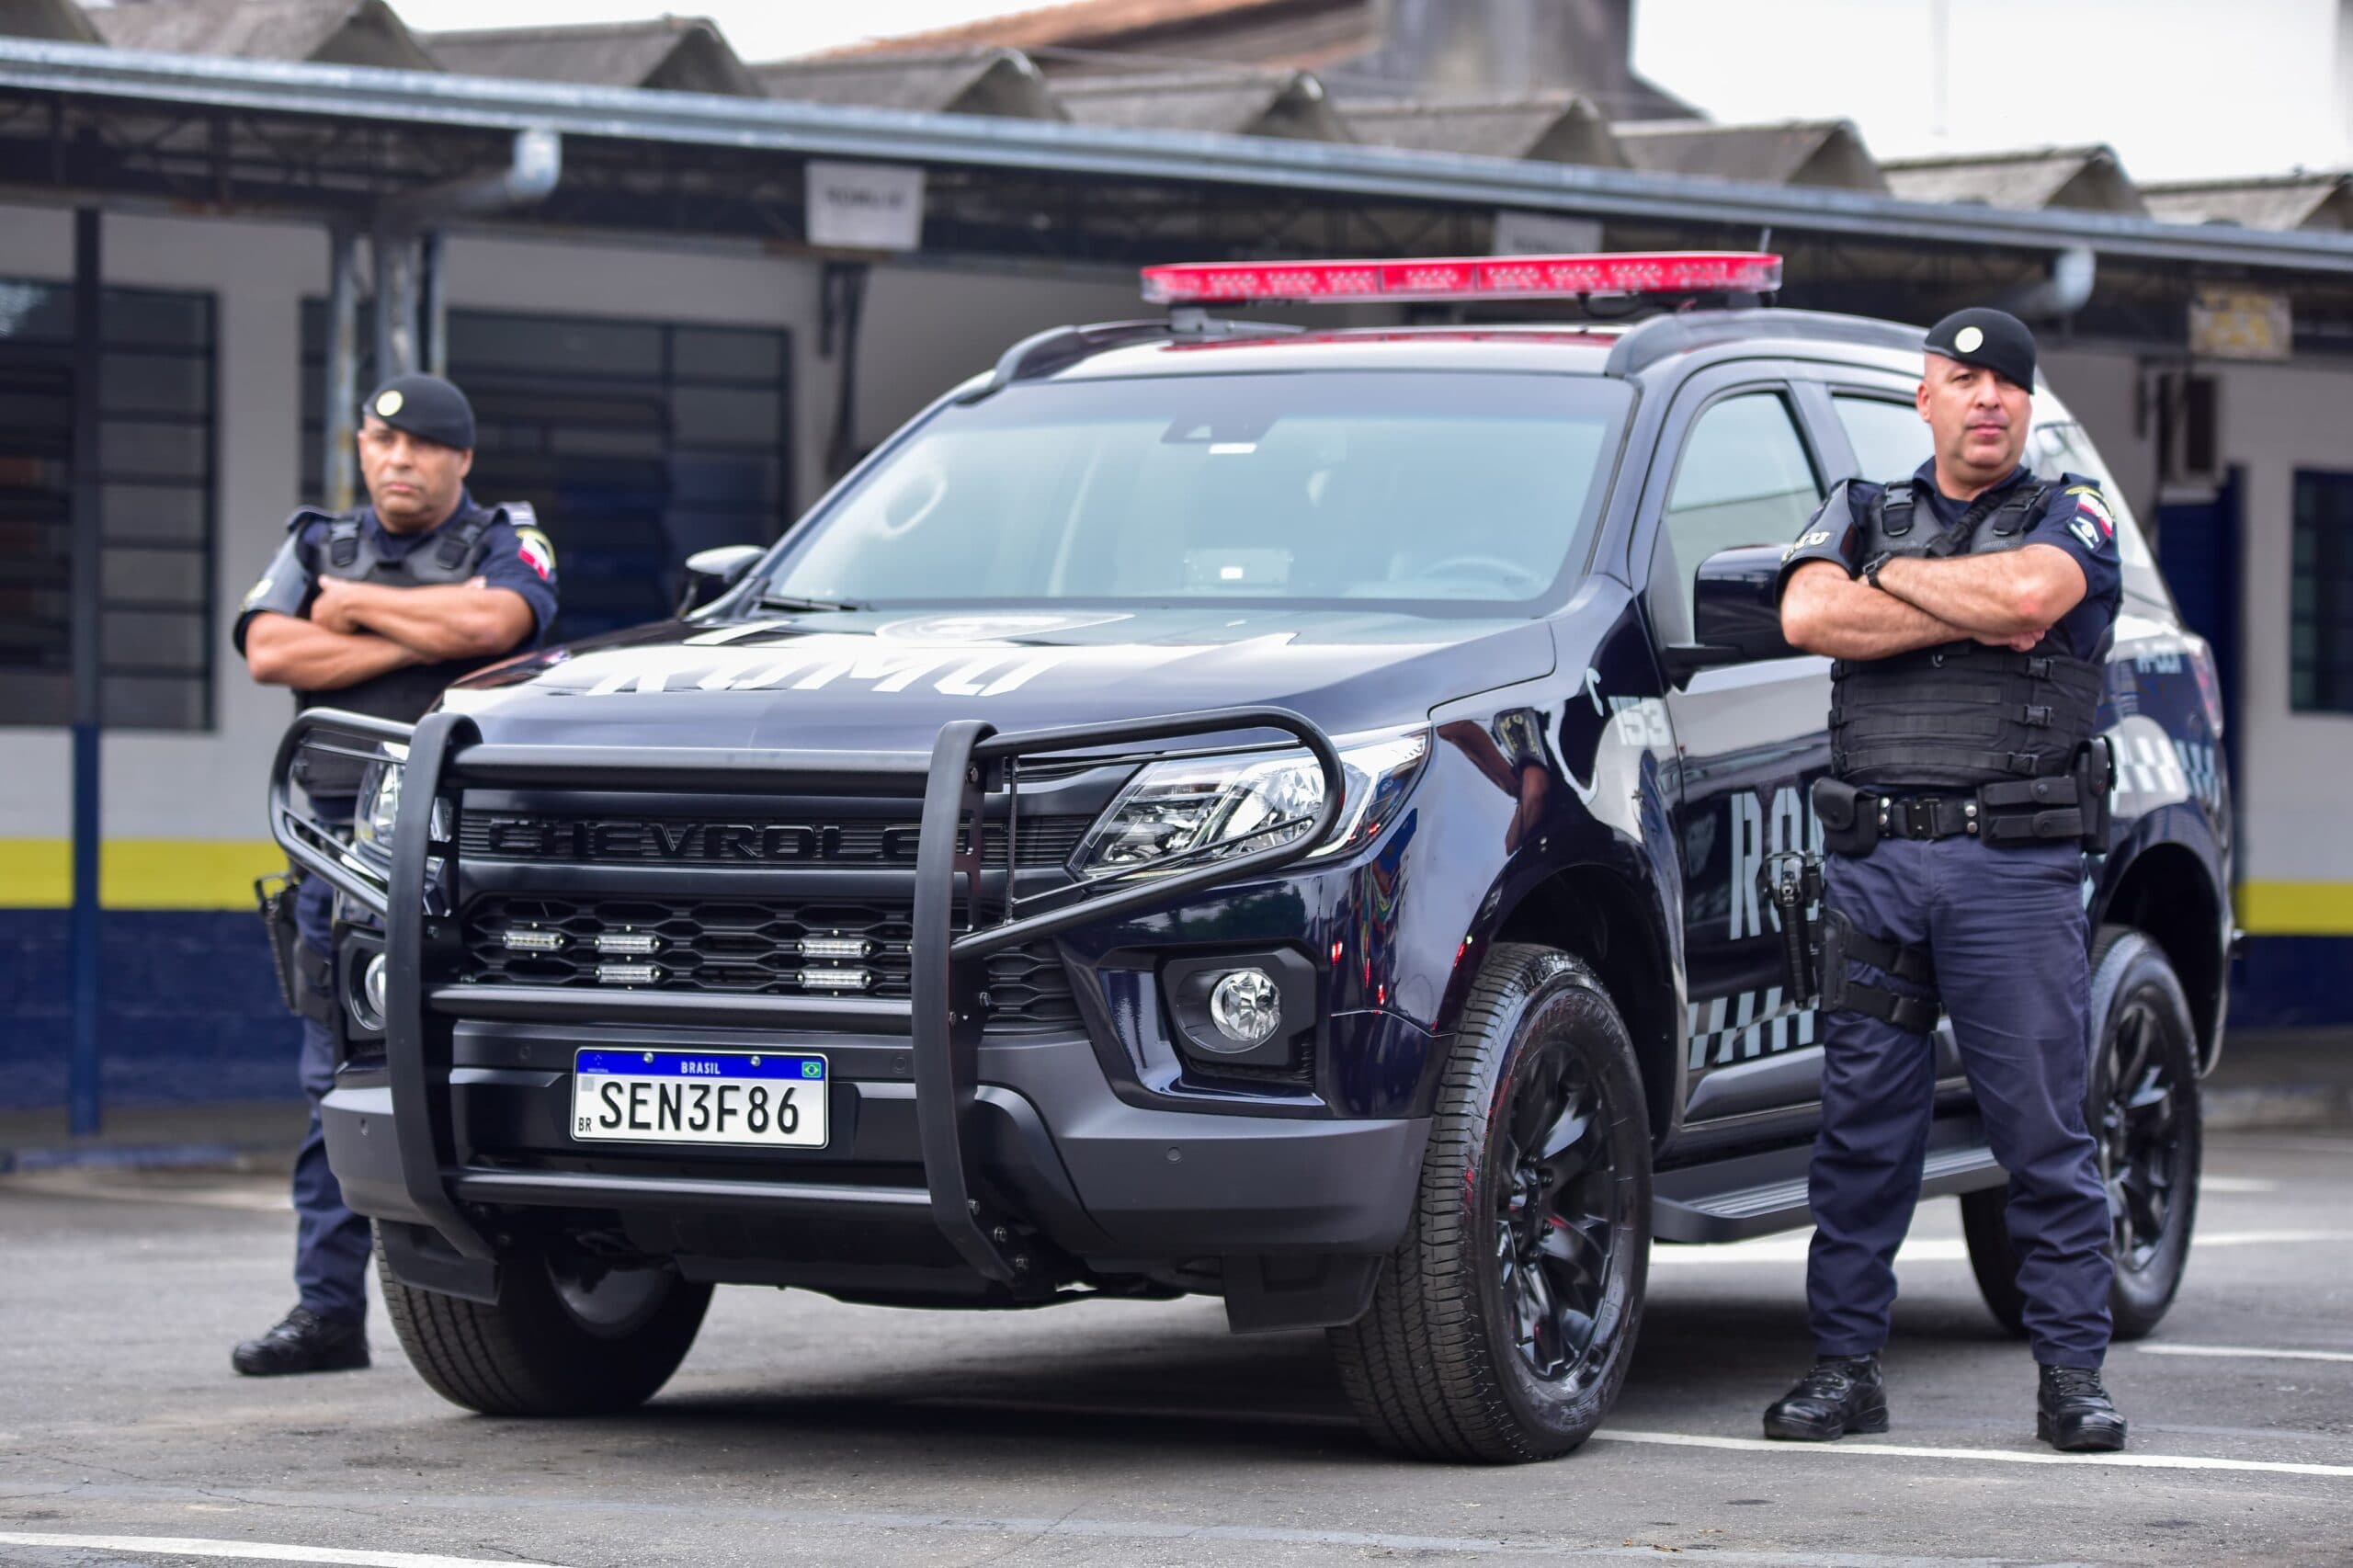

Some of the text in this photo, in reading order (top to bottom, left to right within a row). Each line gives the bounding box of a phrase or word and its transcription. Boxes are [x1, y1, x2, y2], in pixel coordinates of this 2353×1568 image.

[1608, 696, 1671, 746] 153
[1729, 783, 1825, 940] RO
[680, 1061, 721, 1074] BRASIL
[577, 1117, 593, 1133] BR
[598, 1081, 799, 1134] SEN3F86
